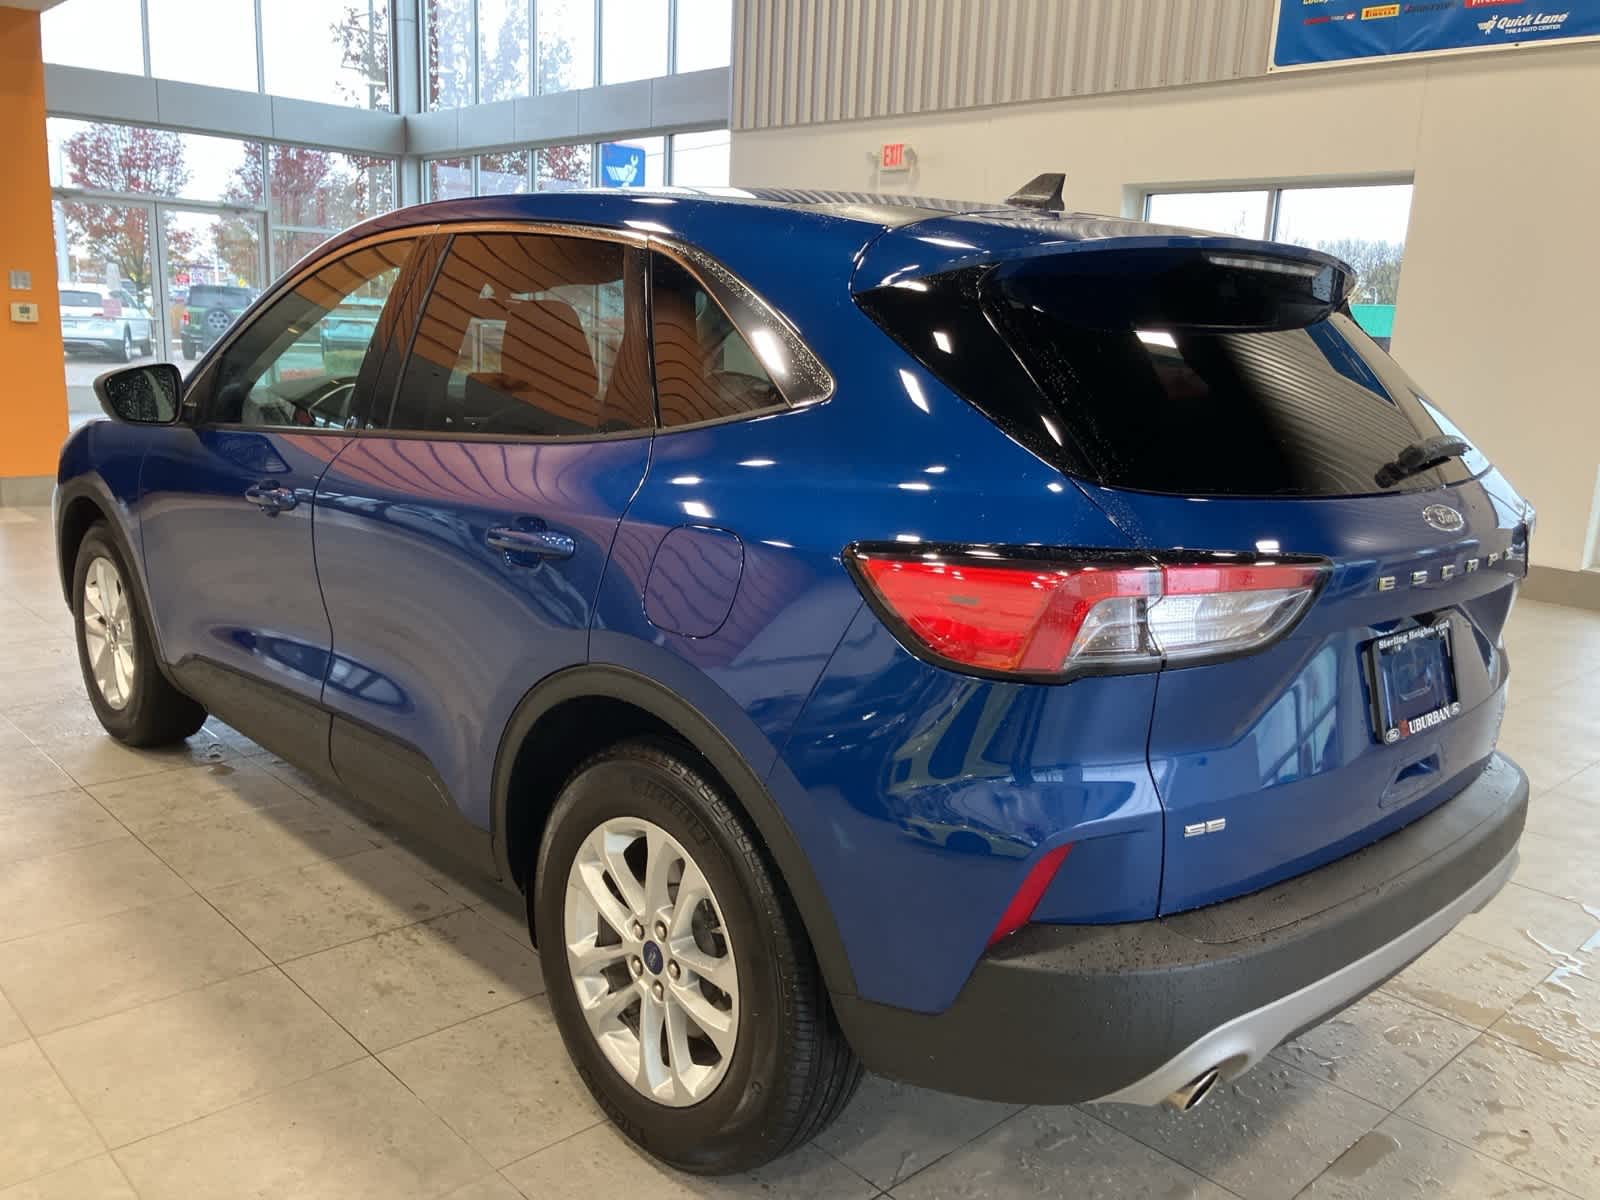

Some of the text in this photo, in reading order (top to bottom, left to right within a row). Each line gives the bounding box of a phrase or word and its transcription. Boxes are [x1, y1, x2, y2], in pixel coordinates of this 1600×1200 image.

[1497, 12, 1569, 30] Quick Lane
[883, 144, 905, 167] EXIT
[1378, 634, 1408, 649] Sterling
[1408, 626, 1435, 641] Heights
